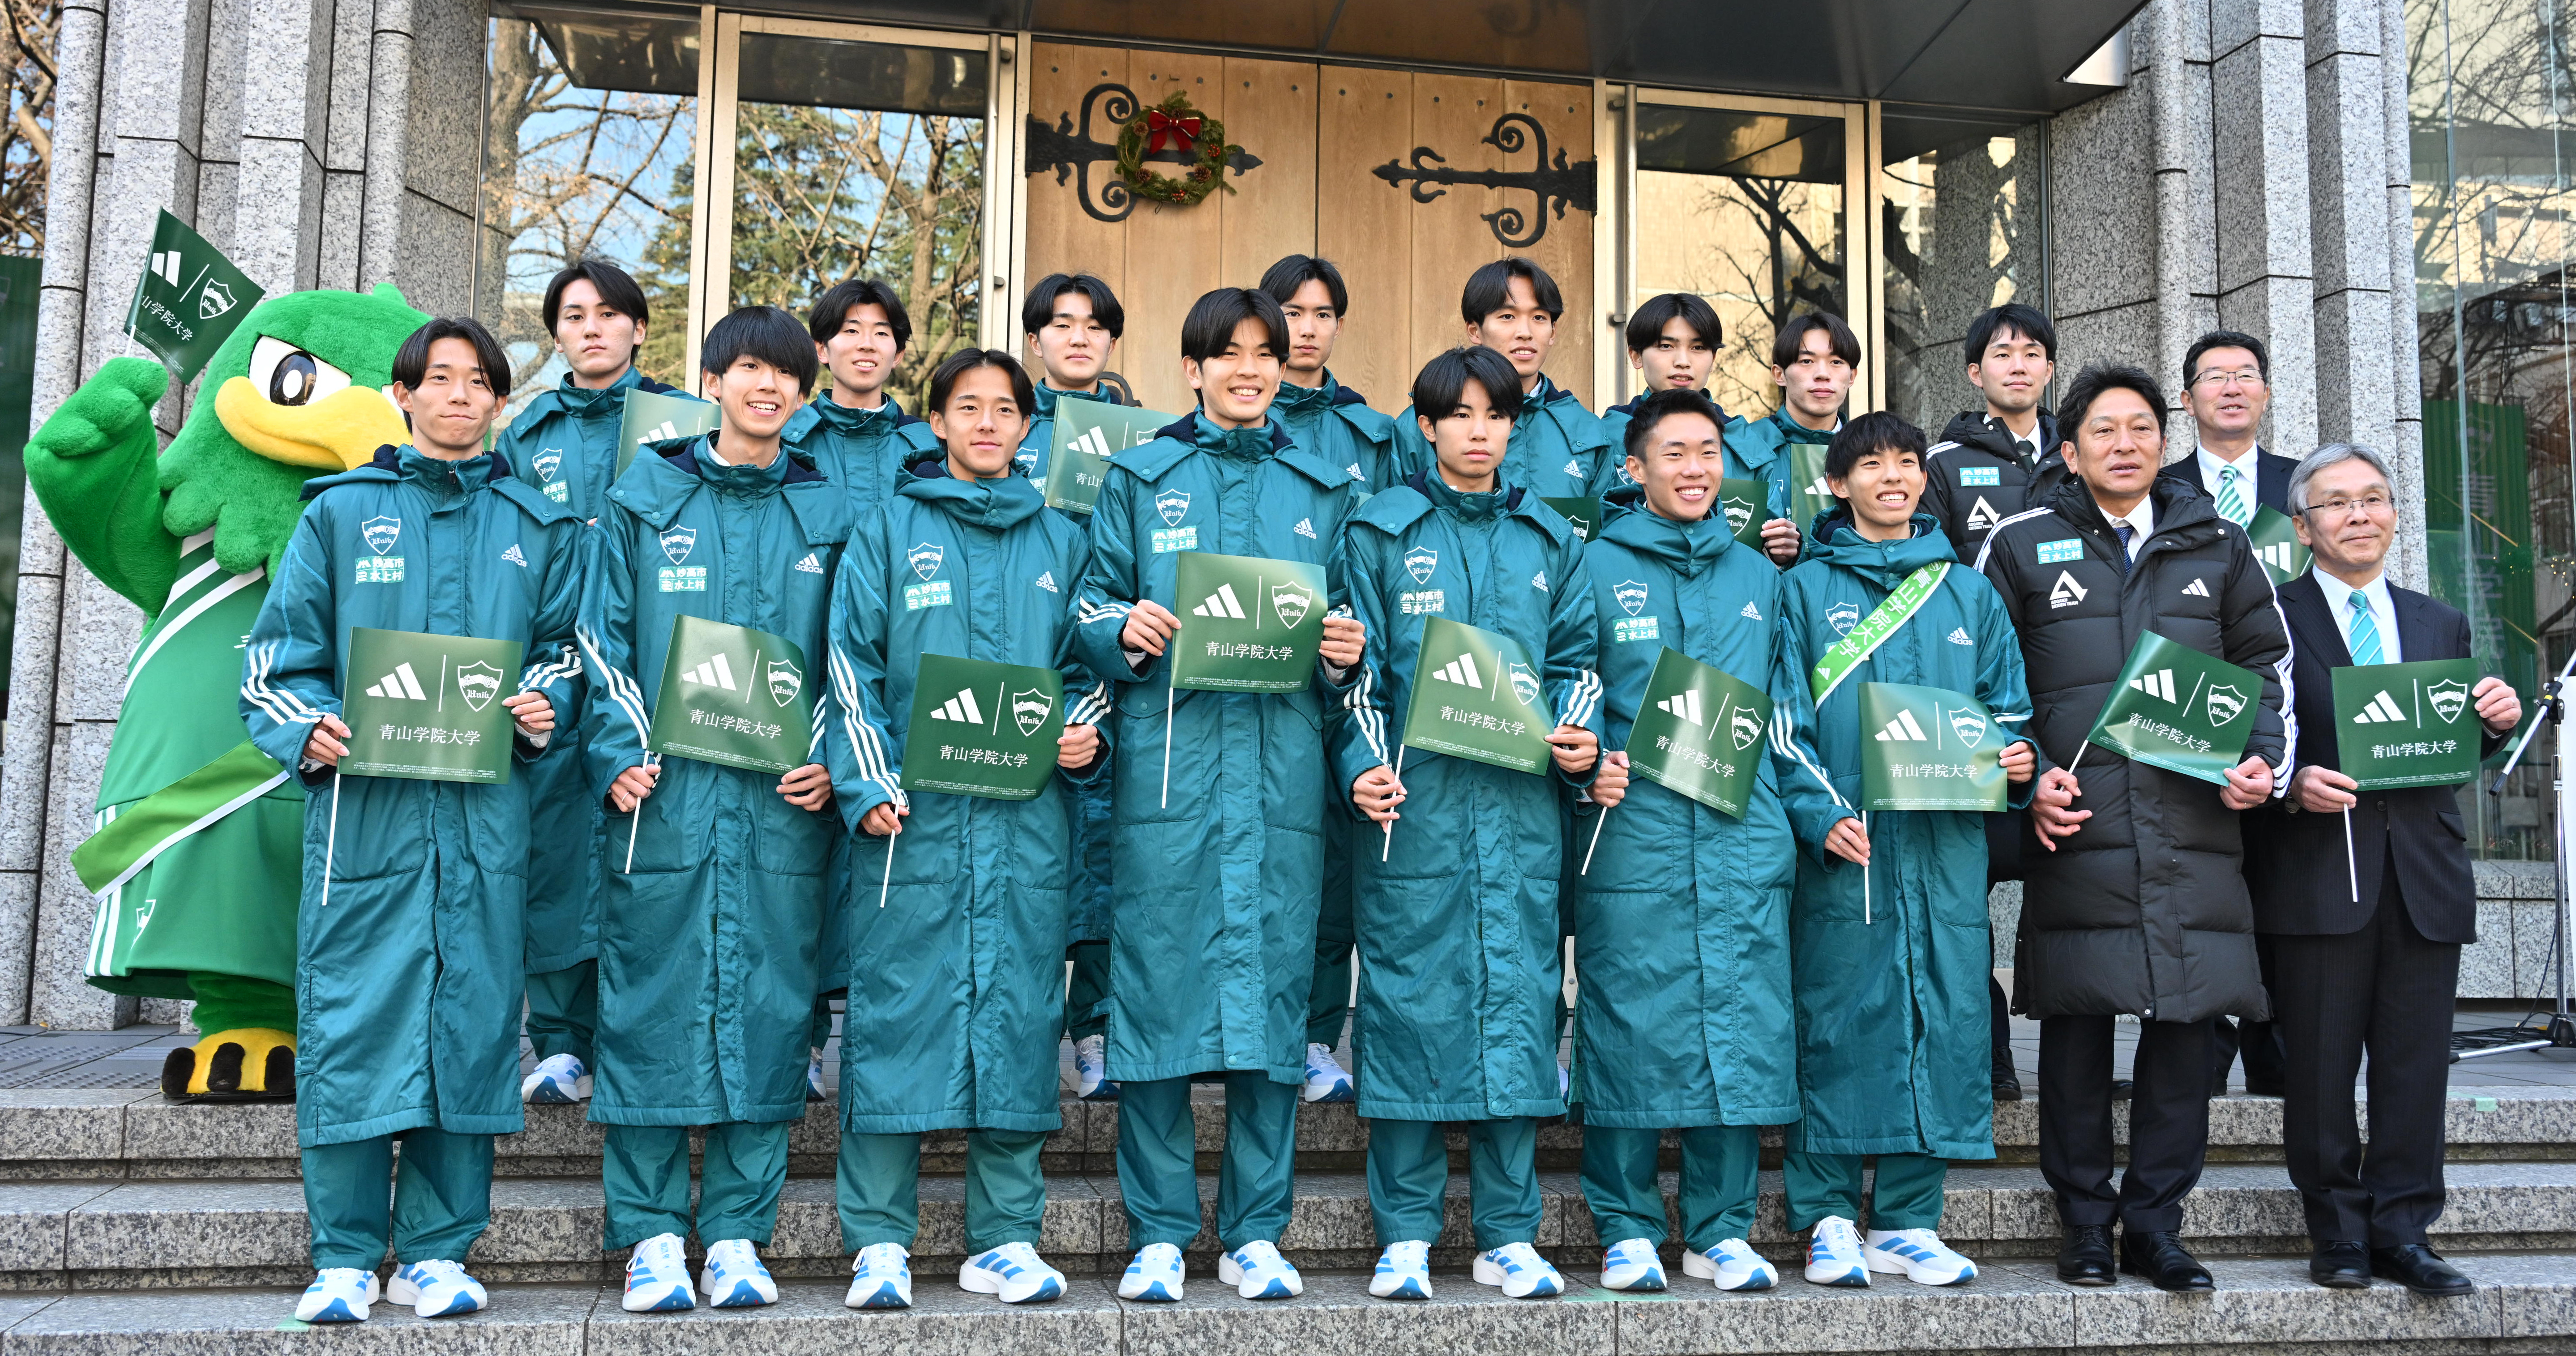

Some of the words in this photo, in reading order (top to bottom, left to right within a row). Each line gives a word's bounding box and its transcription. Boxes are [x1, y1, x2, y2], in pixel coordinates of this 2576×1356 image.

[141, 295, 193, 341] 山学院大学
[1564, 468, 1583, 478] adidas
[1075, 472, 1104, 487] 青山
[1293, 527, 1317, 539] adidas
[2053, 540, 2081, 550] 妙高市
[501, 554, 527, 567] adidas
[2053, 550, 2081, 561] 水上村
[676, 567, 706, 577] 妙高市
[795, 564, 823, 574] adidas
[370, 570, 403, 581] 水上村
[674, 580, 706, 589] 水上村
[921, 582, 949, 594] 妙高市
[1036, 580, 1058, 593] adidas
[1532, 580, 1548, 592] adidas
[920, 593, 950, 606] 水上村
[1416, 591, 1443, 601] 妙高市
[1413, 602, 1442, 614] 水上村
[1839, 567, 1932, 658] 青山学院大学
[1741, 611, 1762, 621] adidas
[1628, 618, 1657, 628] 妙高市
[1628, 629, 1656, 640] 水上村
[1947, 636, 1973, 645] adidas
[1206, 641, 1293, 661] 青山学院大学
[689, 709, 782, 738] 青山学院大学
[1440, 706, 1525, 735] 青山学院大学
[379, 724, 480, 746] 青山学院大学
[2129, 712, 2211, 753] 青山学院大学
[2371, 740, 2456, 758] 青山学院大学
[939, 745, 1028, 768] 青山学院大学
[1656, 735, 1734, 777] 青山学院大学
[1890, 764, 1978, 778] 青山学院大学
